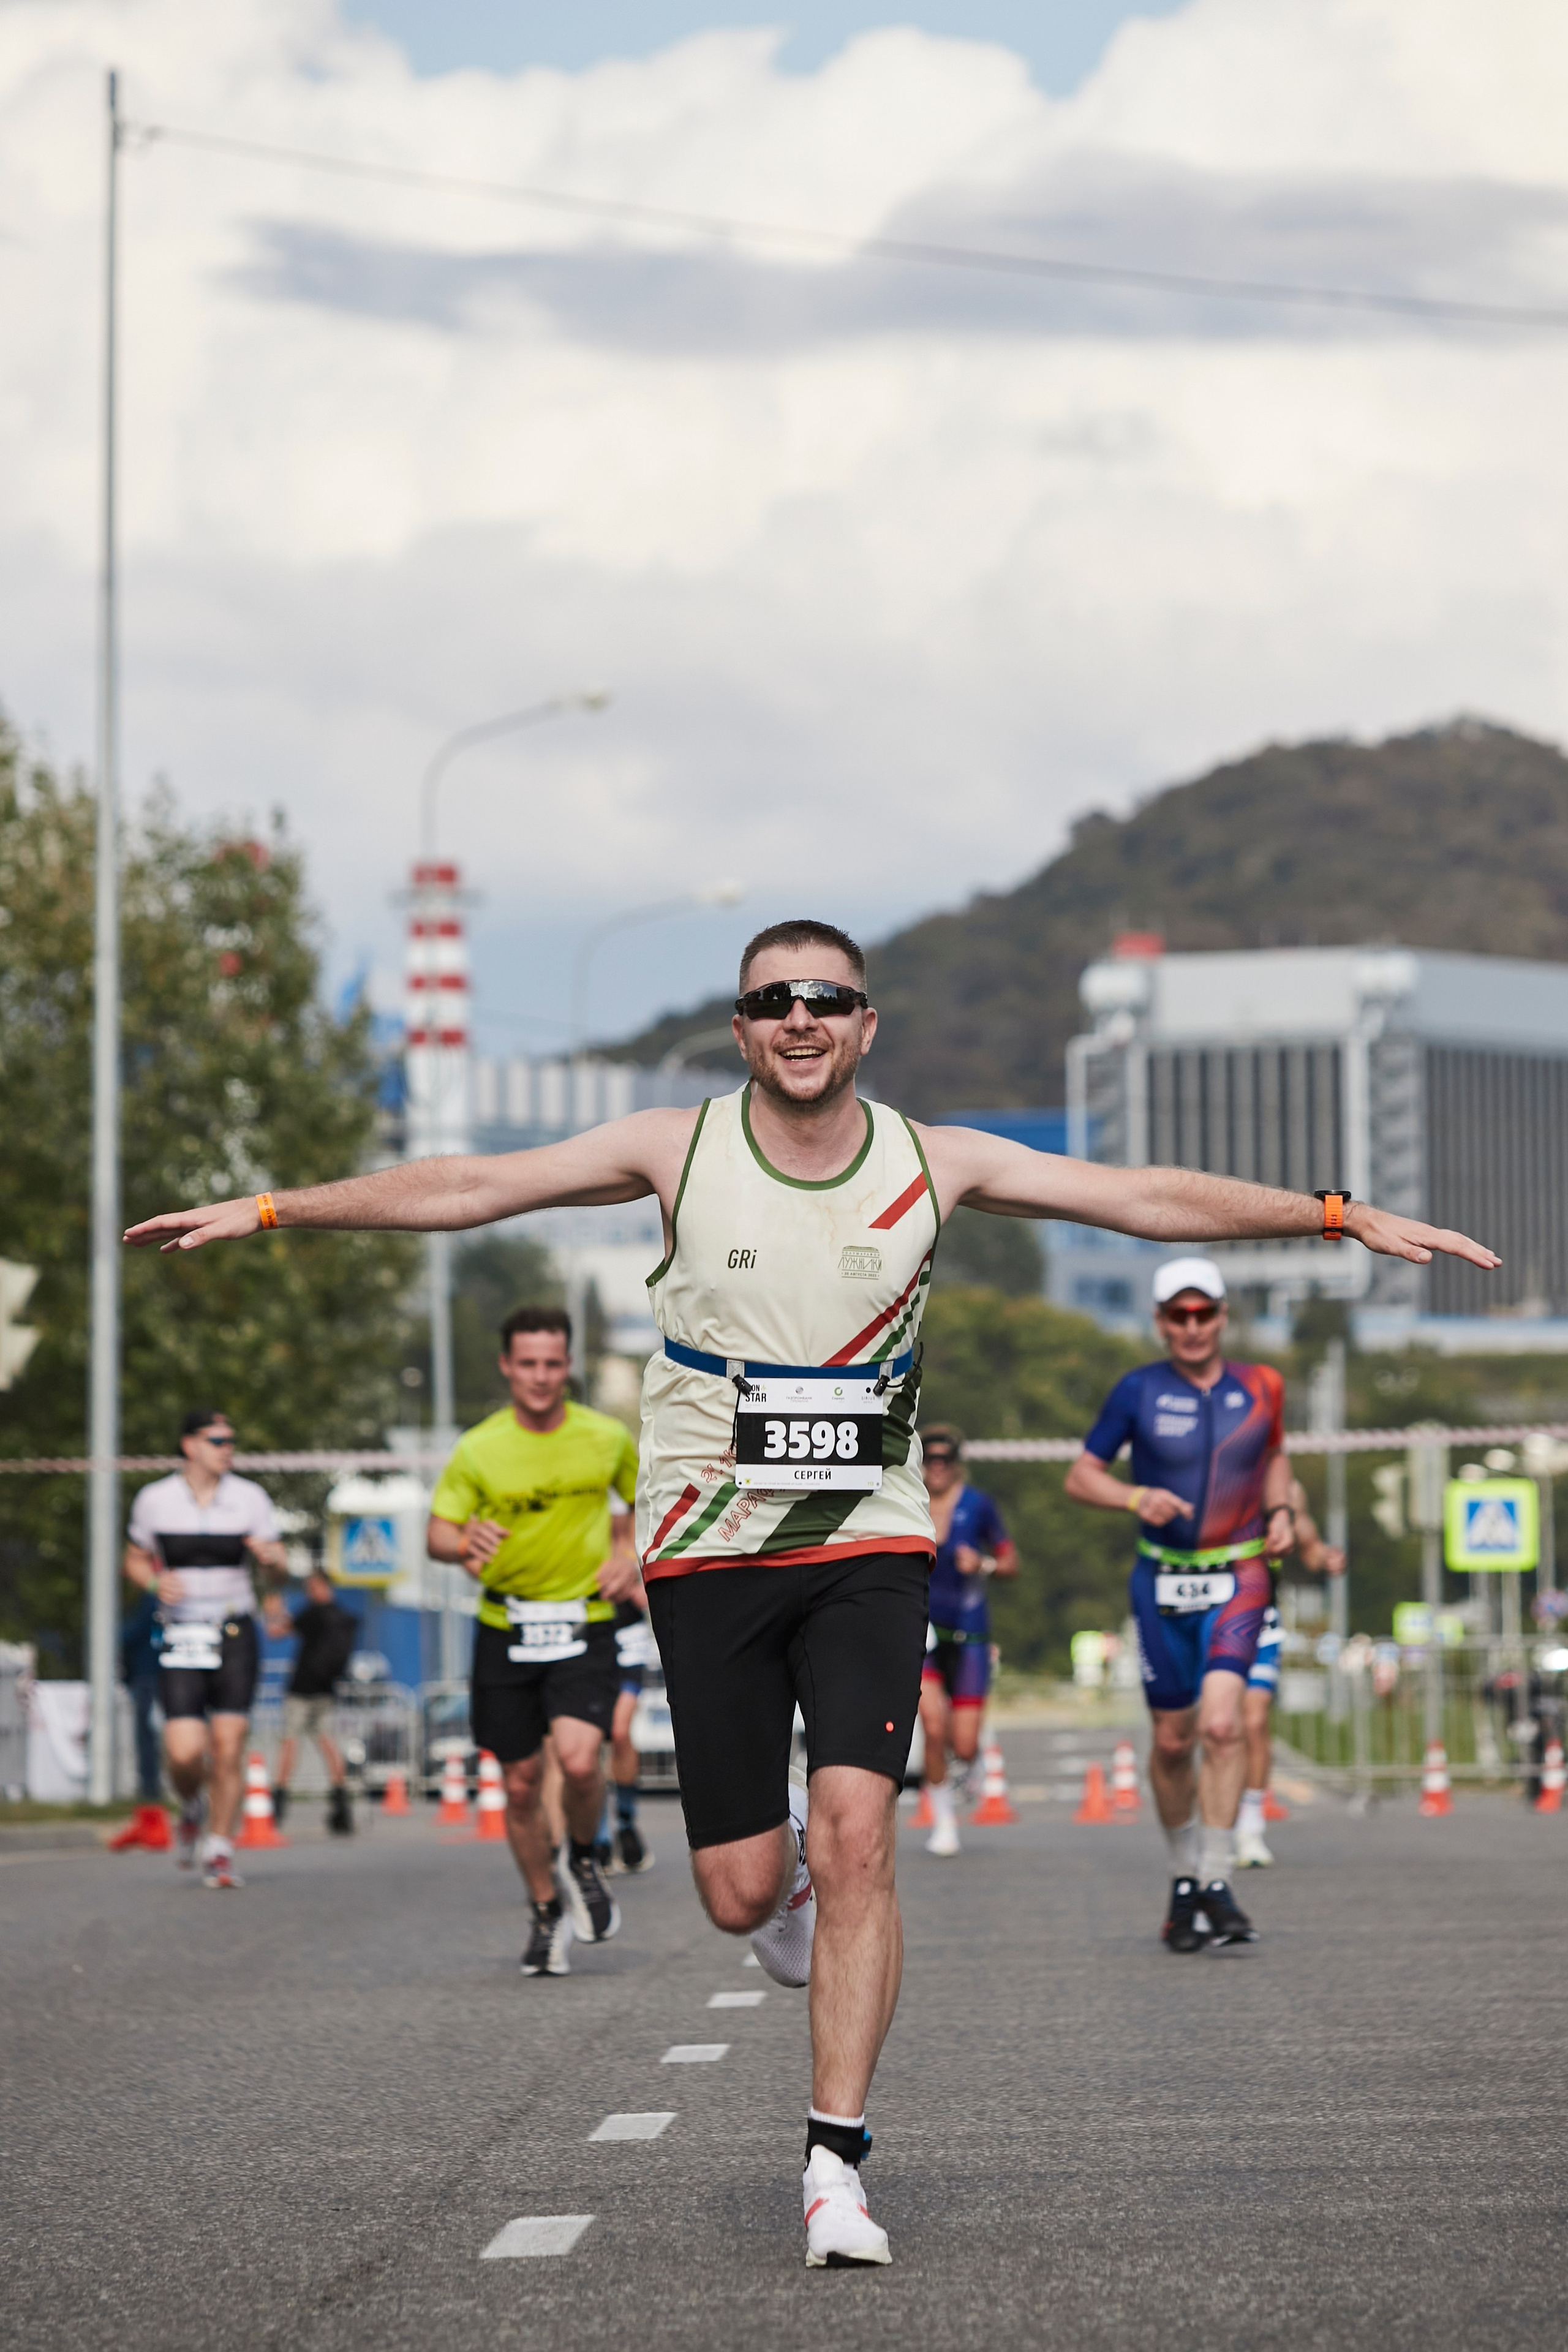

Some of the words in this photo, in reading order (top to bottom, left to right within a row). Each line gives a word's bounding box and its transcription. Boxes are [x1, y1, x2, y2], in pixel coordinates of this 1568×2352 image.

[728, 1249, 757, 1269] GRi
[837, 1256, 882, 1272] ЛУЖНИКИ
[745, 1393, 767, 1402] STAR
[764, 1420, 859, 1460] 3598
[794, 1468, 832, 1480] СЕРГЕЙ
